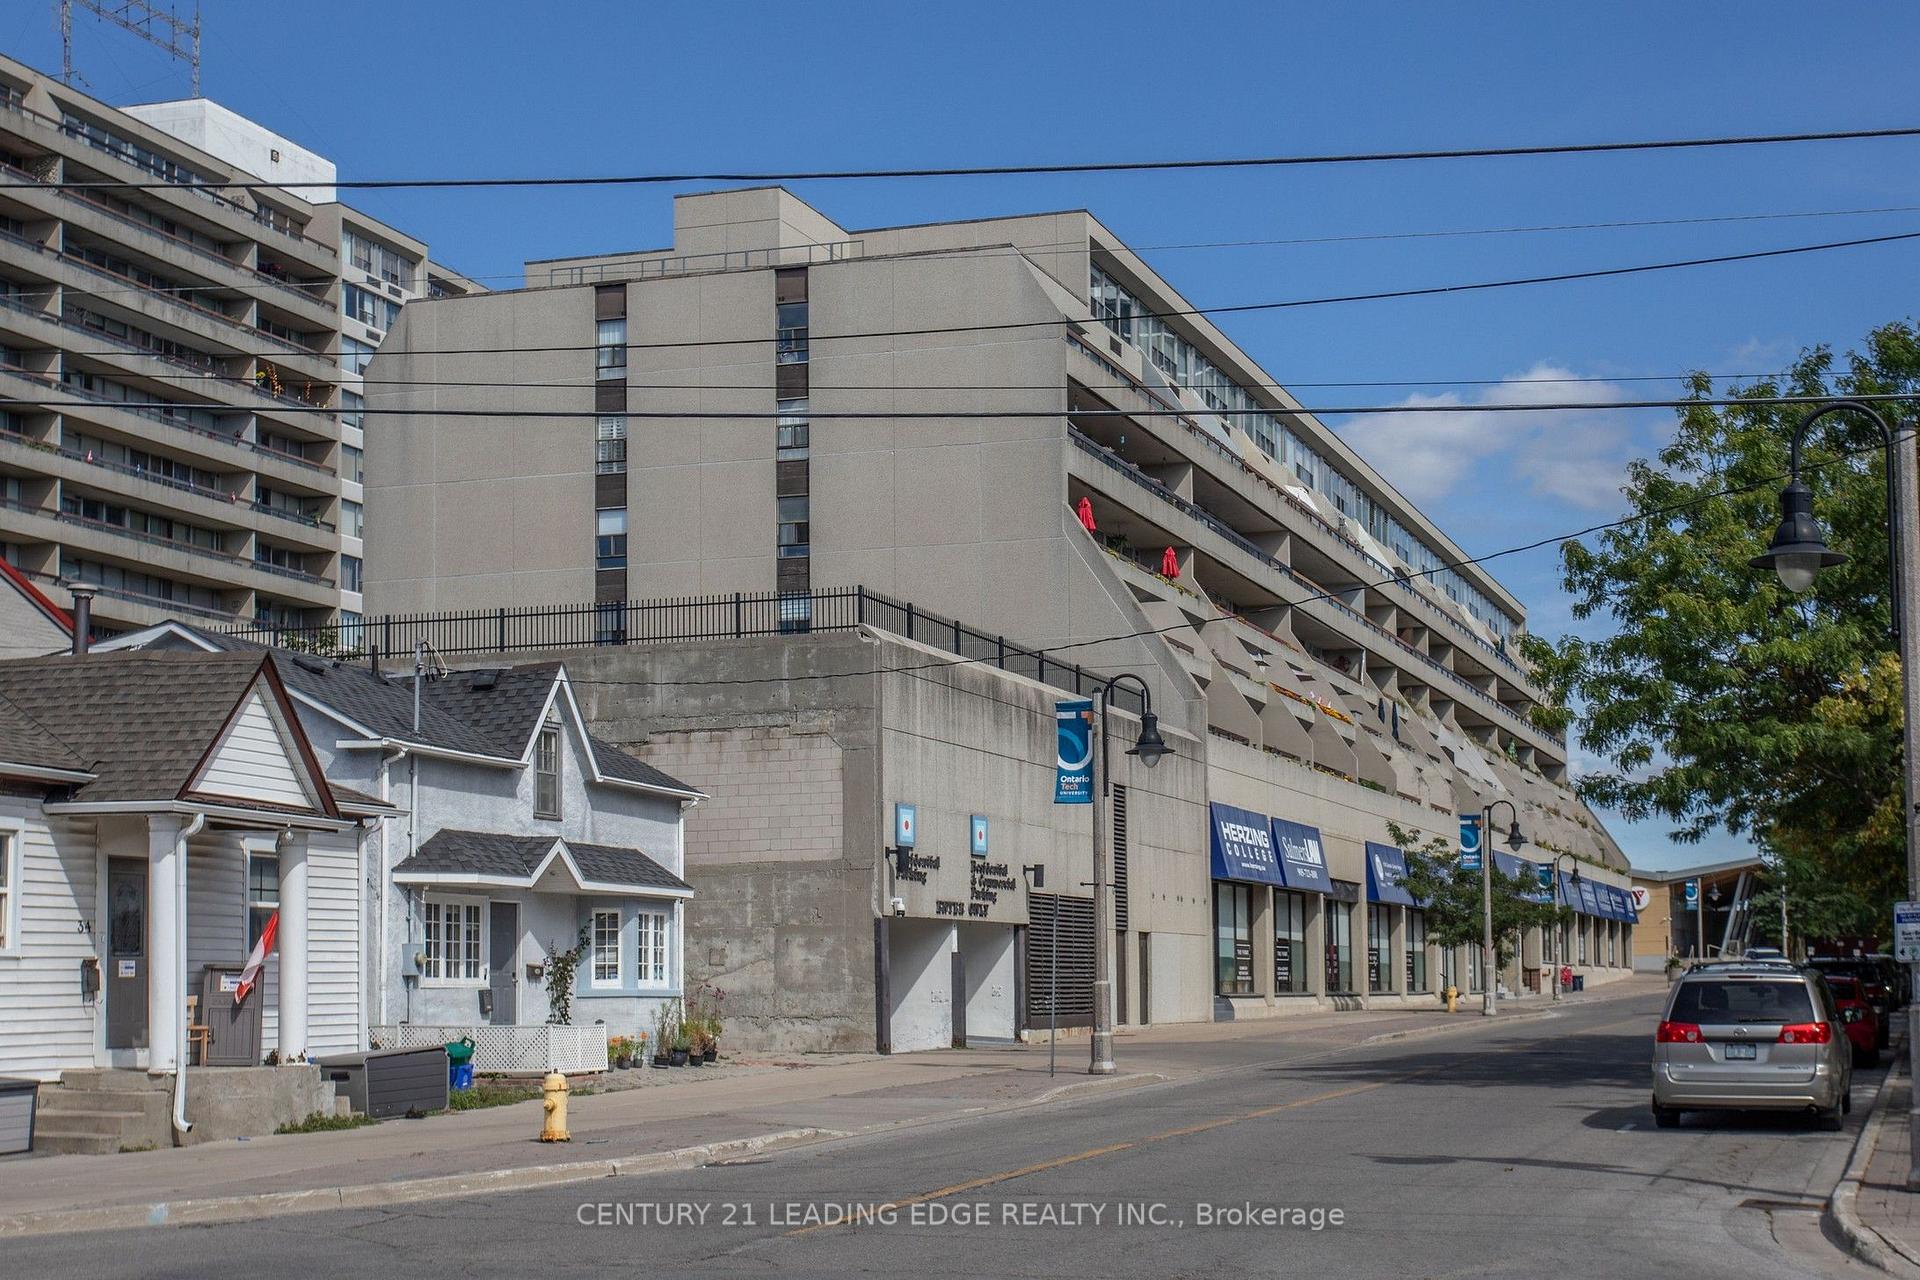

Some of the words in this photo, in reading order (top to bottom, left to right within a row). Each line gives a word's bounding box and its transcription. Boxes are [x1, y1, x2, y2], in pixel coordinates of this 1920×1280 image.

[1060, 775, 1090, 783] Ontario
[1061, 783, 1079, 791] Tech
[1221, 821, 1269, 848] HERZING
[1226, 841, 1273, 863] COLLEGE
[77, 920, 91, 934] 34
